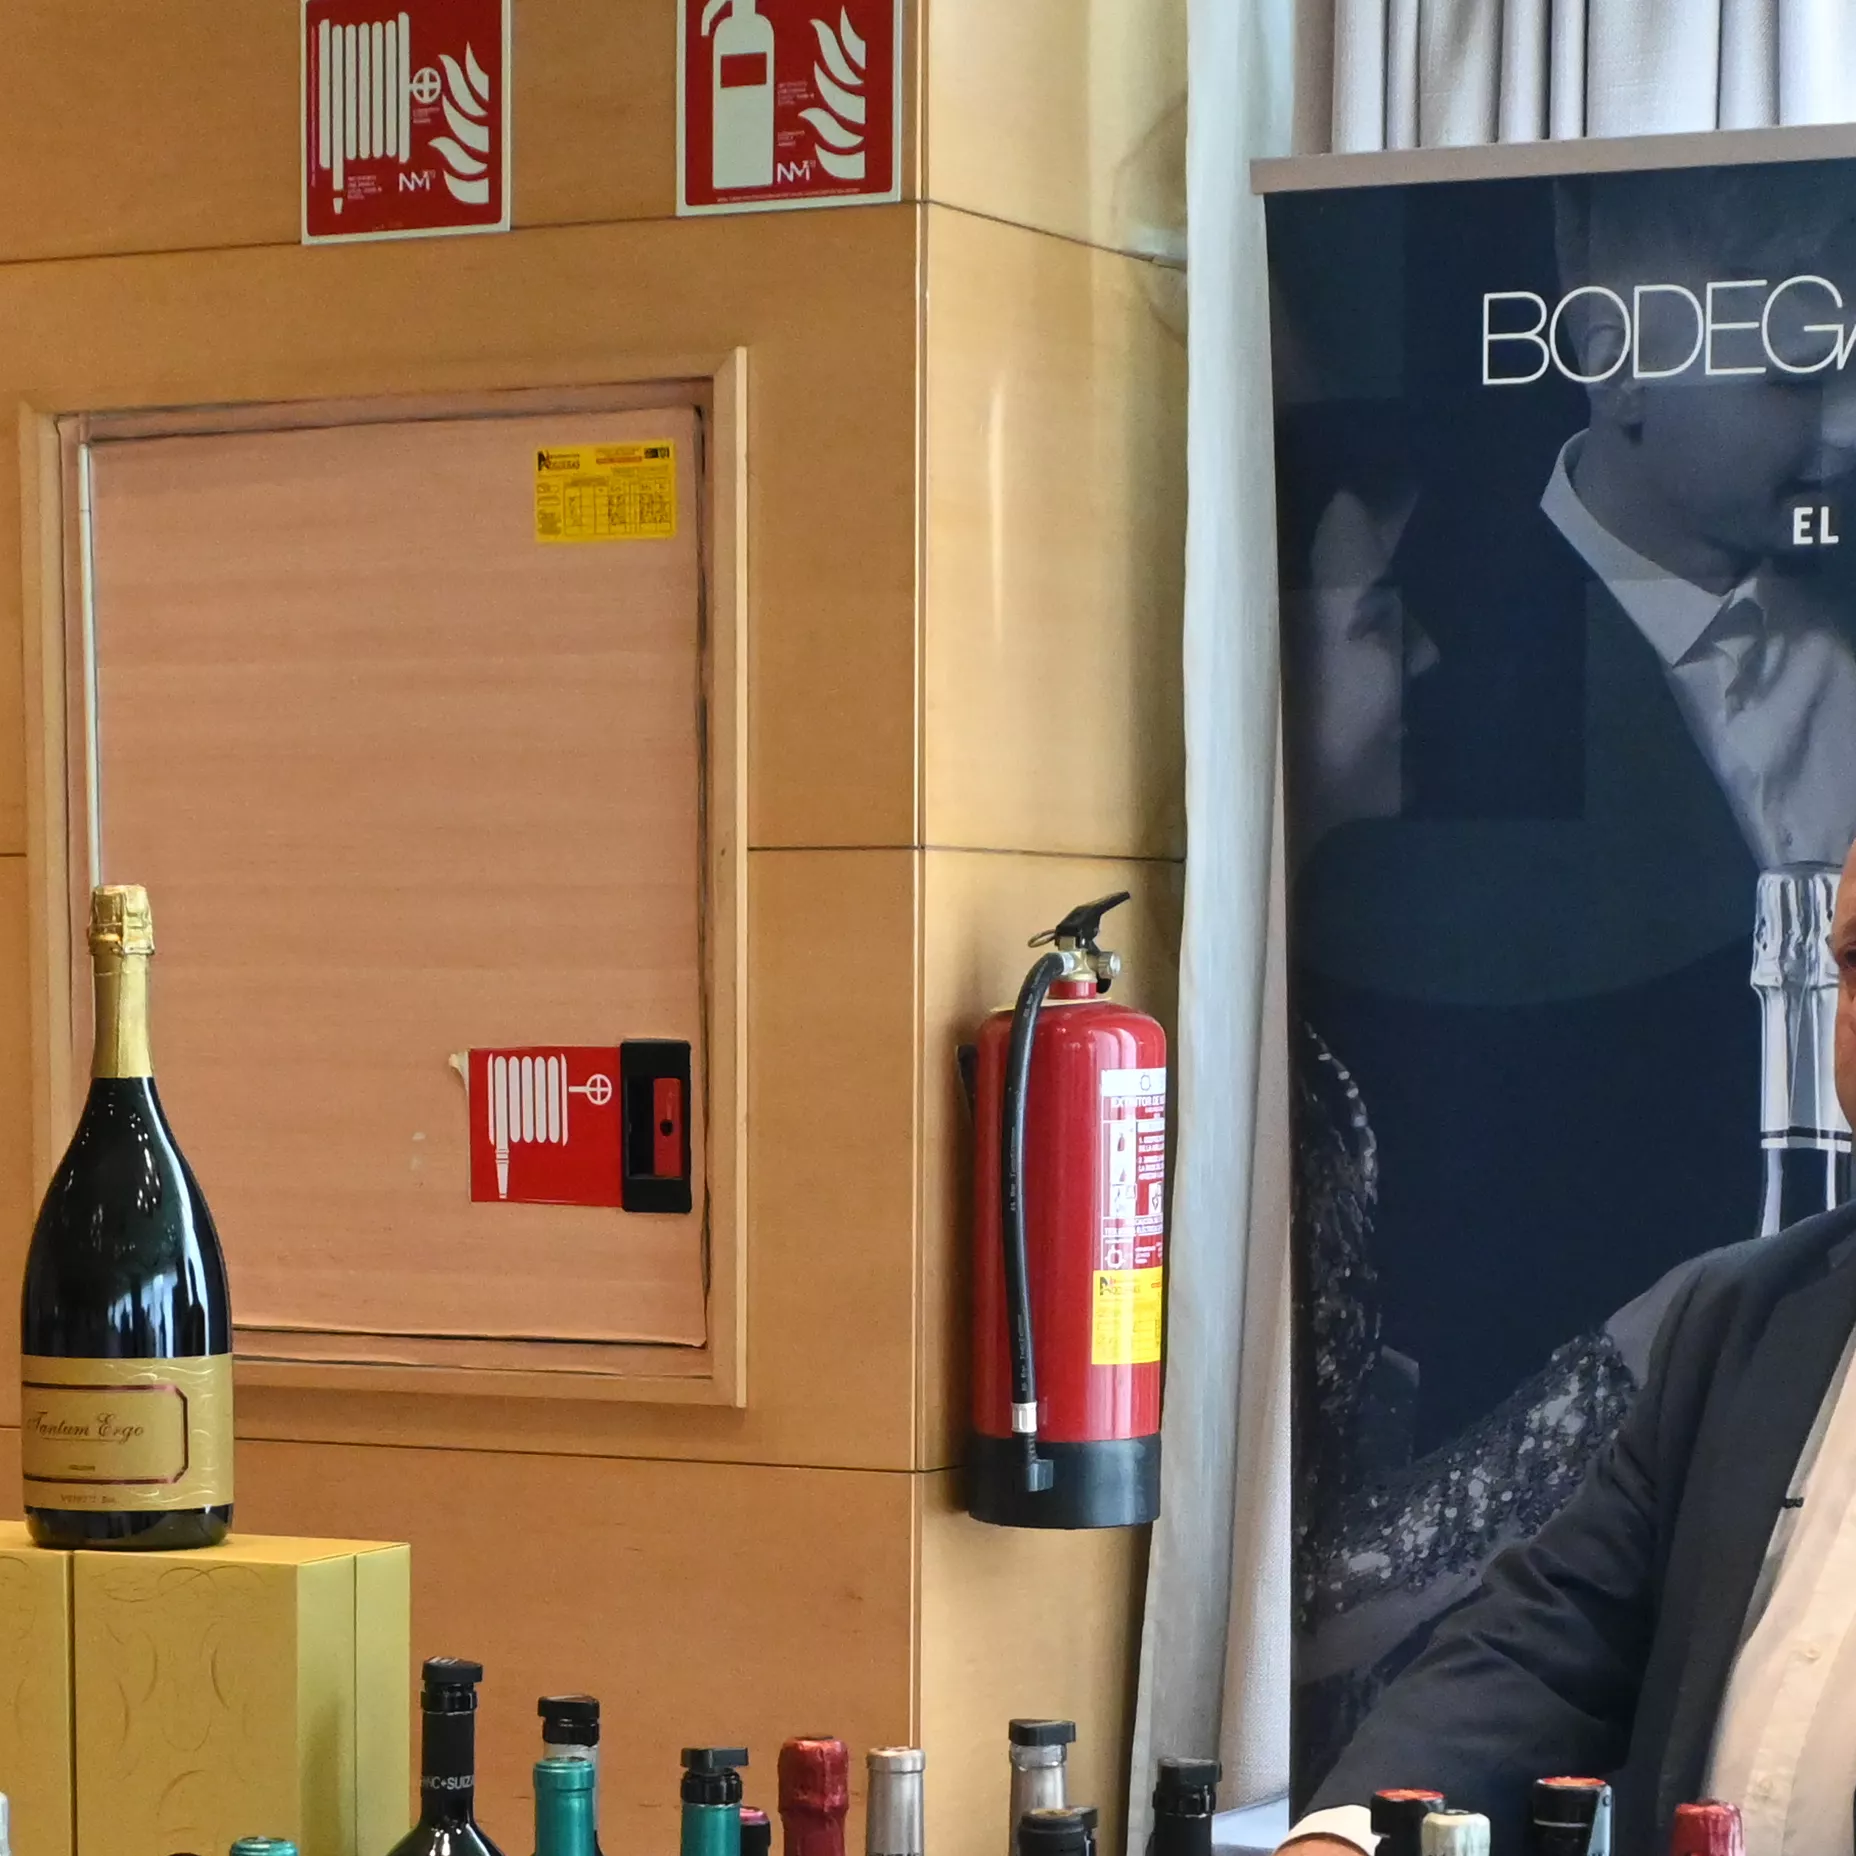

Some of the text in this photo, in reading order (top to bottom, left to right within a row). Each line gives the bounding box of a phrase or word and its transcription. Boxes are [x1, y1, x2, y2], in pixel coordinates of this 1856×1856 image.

[1792, 506, 1839, 545] EL
[27, 1411, 145, 1445] Tantum Ergo
